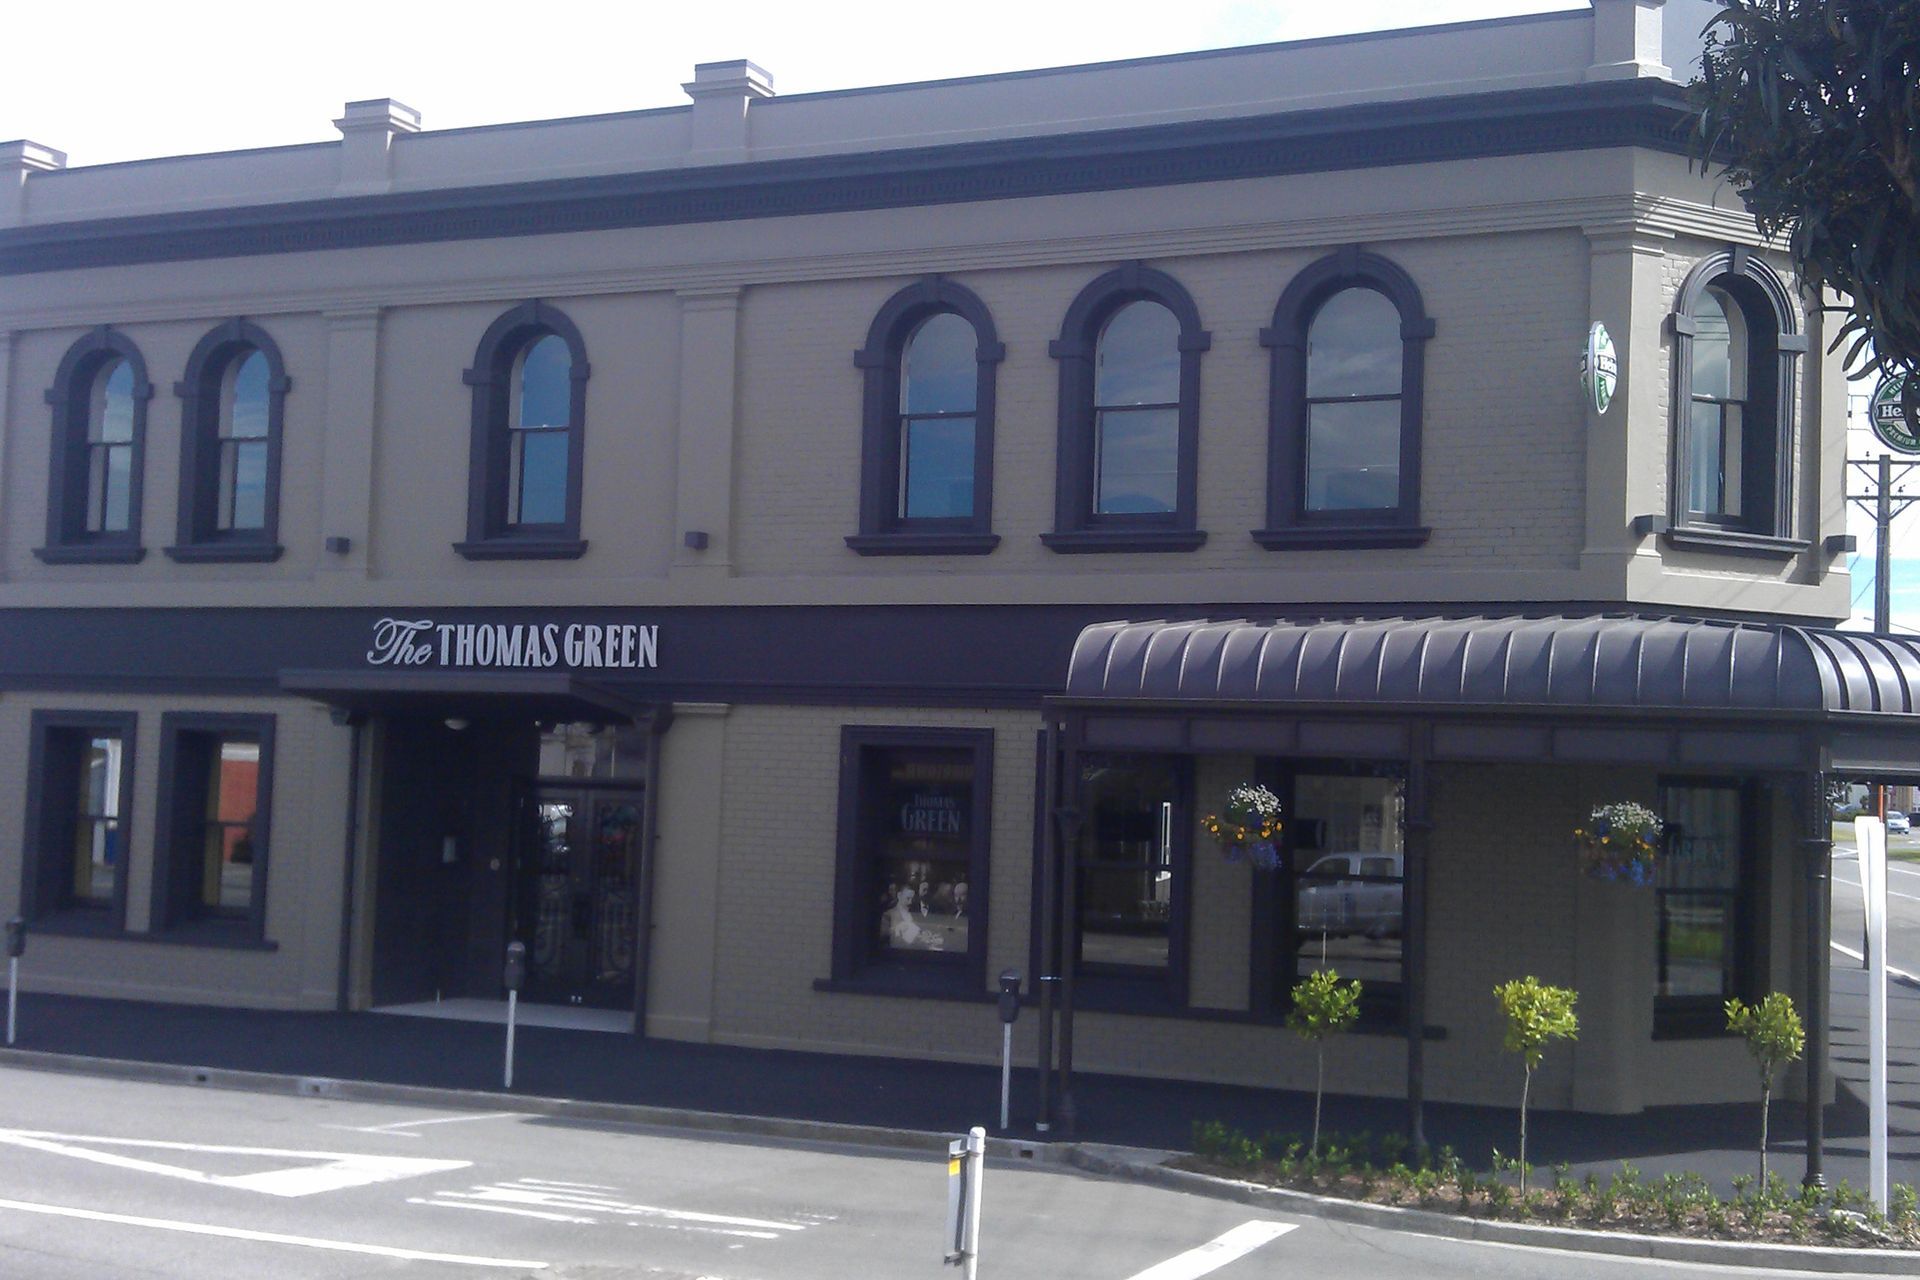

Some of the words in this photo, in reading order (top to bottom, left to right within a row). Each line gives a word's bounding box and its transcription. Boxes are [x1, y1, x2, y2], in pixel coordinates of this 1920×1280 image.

[1881, 405, 1904, 417] He
[366, 617, 434, 665] The
[436, 623, 559, 667] THOMAS
[564, 623, 659, 668] GREEN
[901, 803, 960, 833] GREEN
